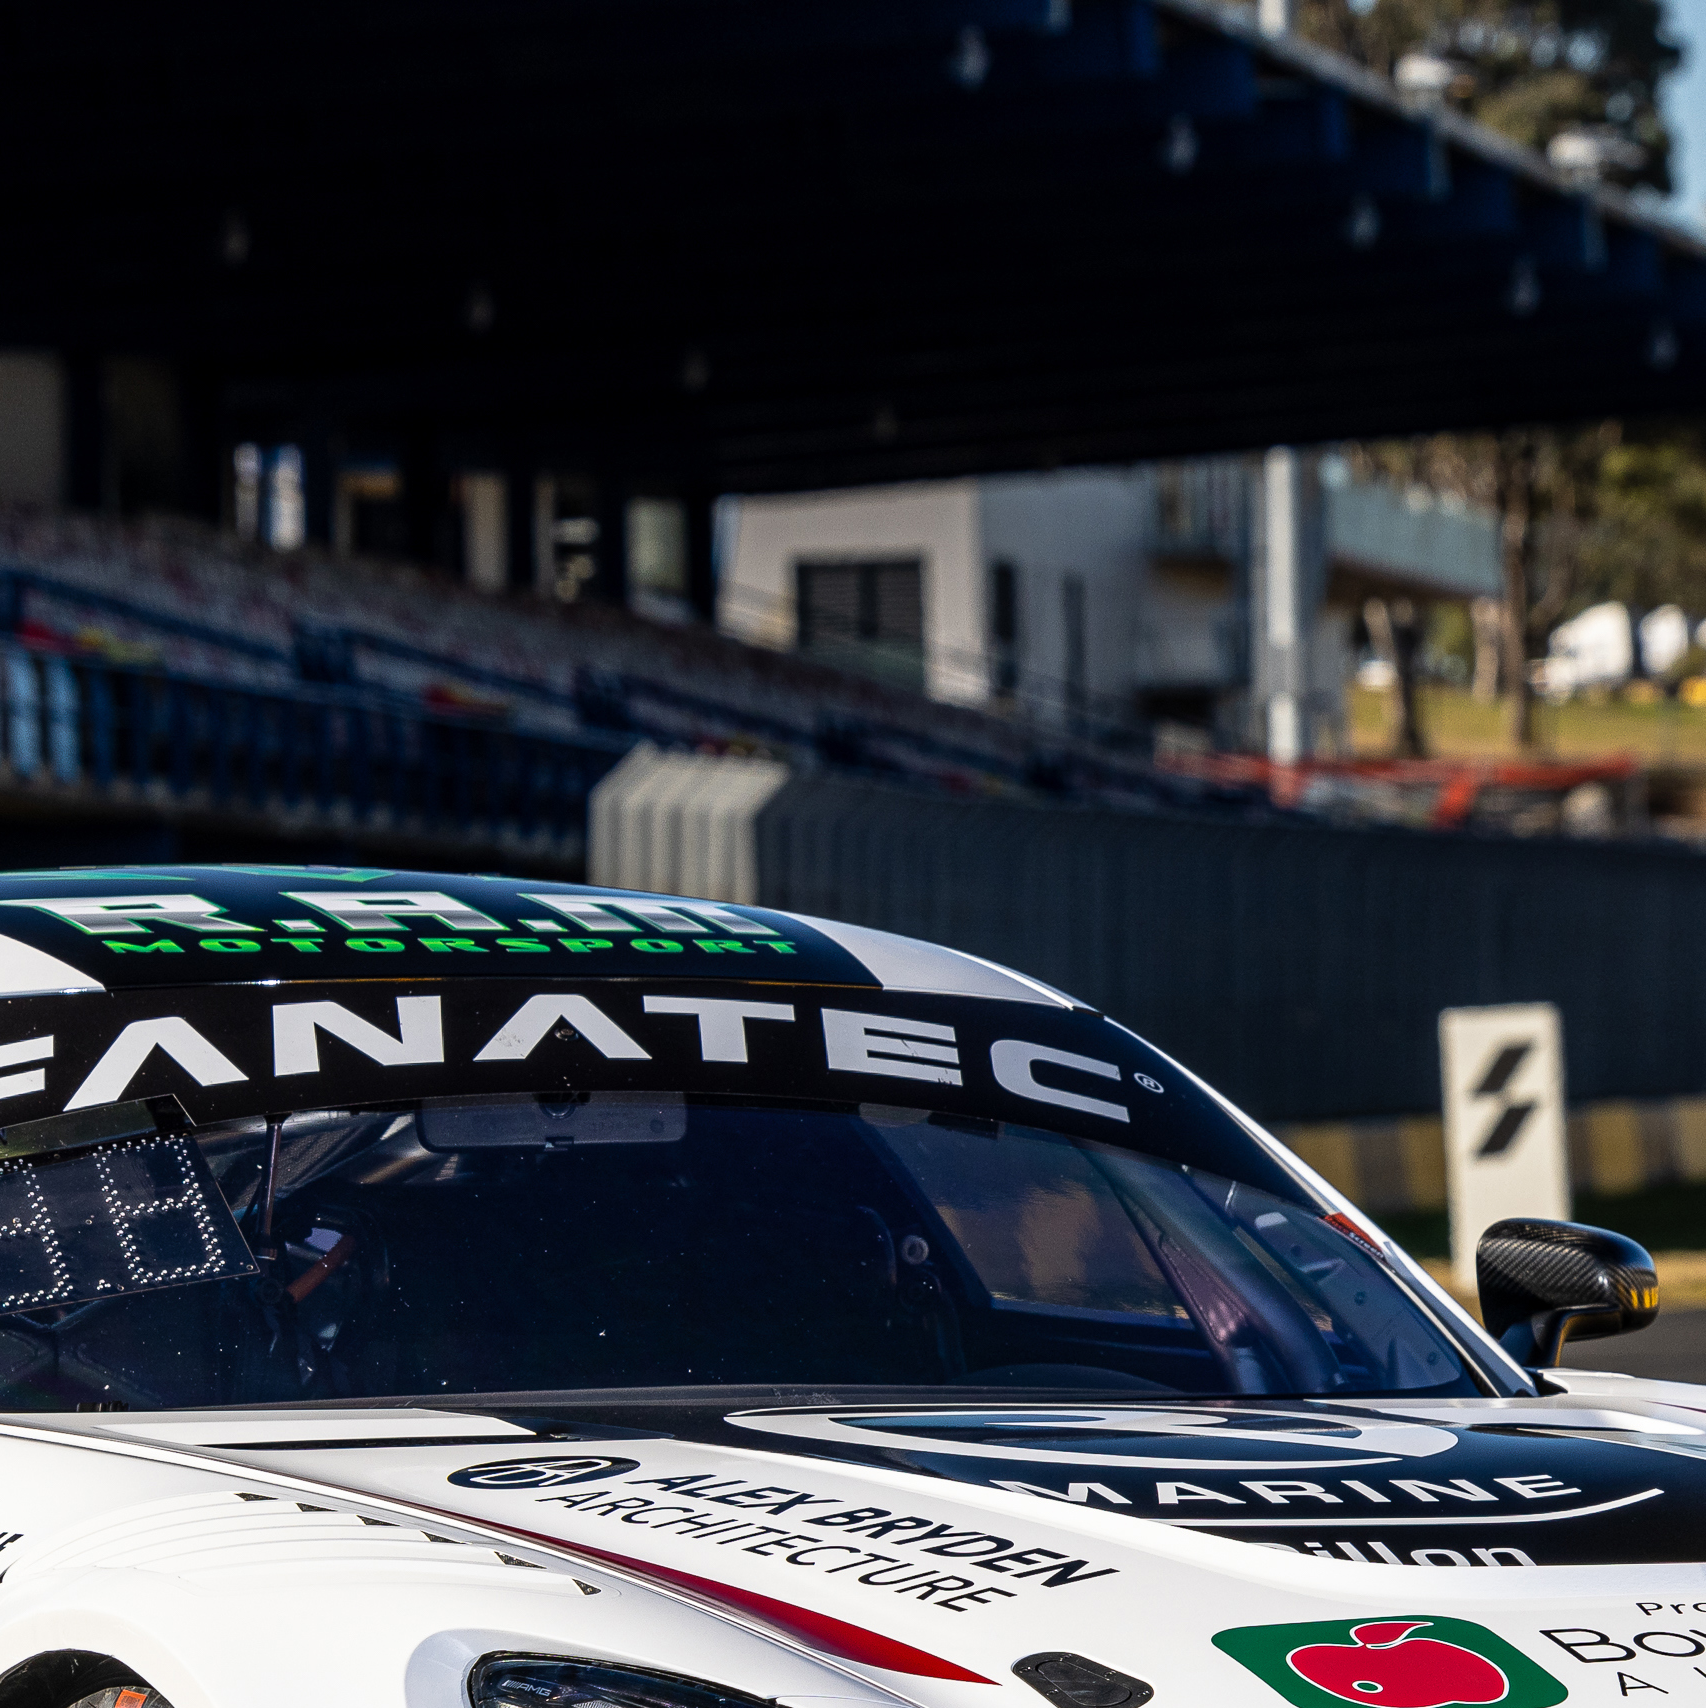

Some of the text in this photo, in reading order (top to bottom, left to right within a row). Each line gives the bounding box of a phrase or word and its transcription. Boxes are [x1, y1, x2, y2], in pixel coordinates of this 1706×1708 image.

[102, 937, 797, 956] MOTORSPORT
[990, 1475, 1581, 1504] MARINE
[536, 1490, 1018, 1612] ARCHITECTURE
[623, 1474, 1119, 1590] ALEX BRYDEN
